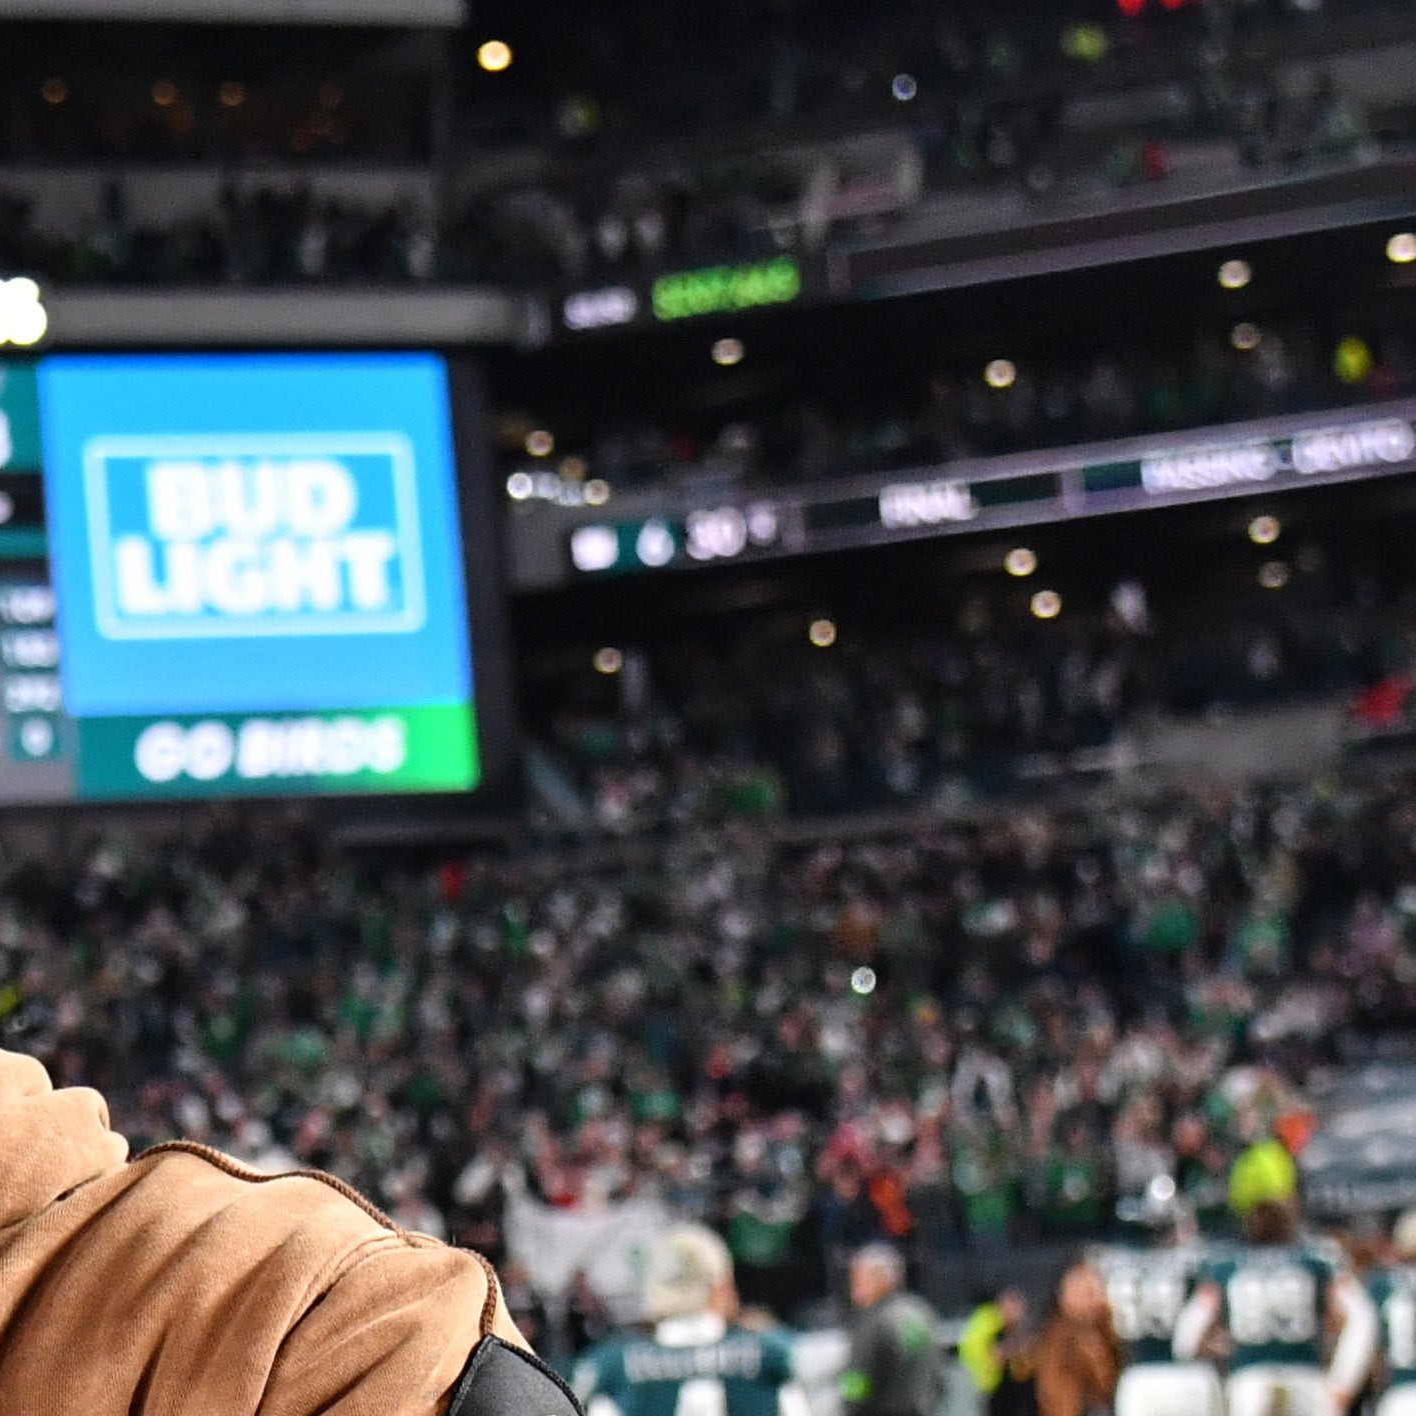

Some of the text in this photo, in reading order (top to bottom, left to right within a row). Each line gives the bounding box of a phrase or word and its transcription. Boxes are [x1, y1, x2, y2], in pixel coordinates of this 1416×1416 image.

[147, 459, 357, 540] BUD
[116, 531, 395, 614] LIGHT
[134, 715, 408, 782] GO BIRDS
